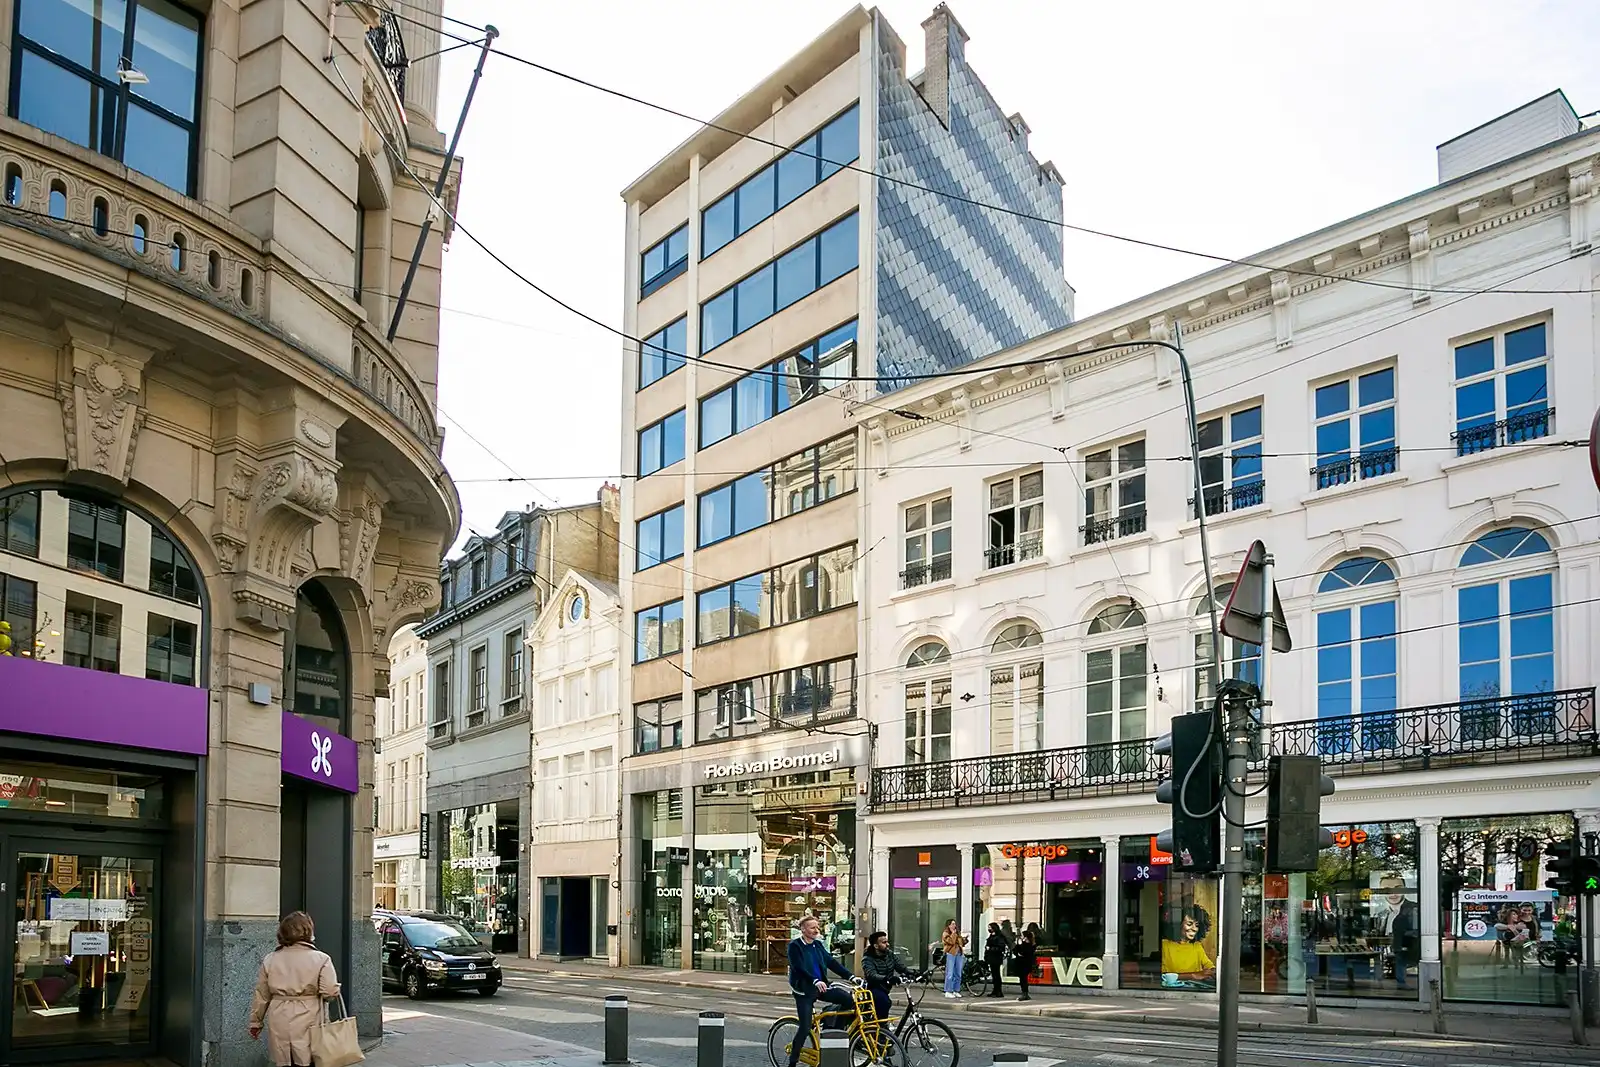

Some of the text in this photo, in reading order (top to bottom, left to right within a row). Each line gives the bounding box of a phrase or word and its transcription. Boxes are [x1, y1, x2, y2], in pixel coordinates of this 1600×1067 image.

[704, 746, 839, 778] Floris van Bommel
[1001, 843, 1068, 860] Orange
